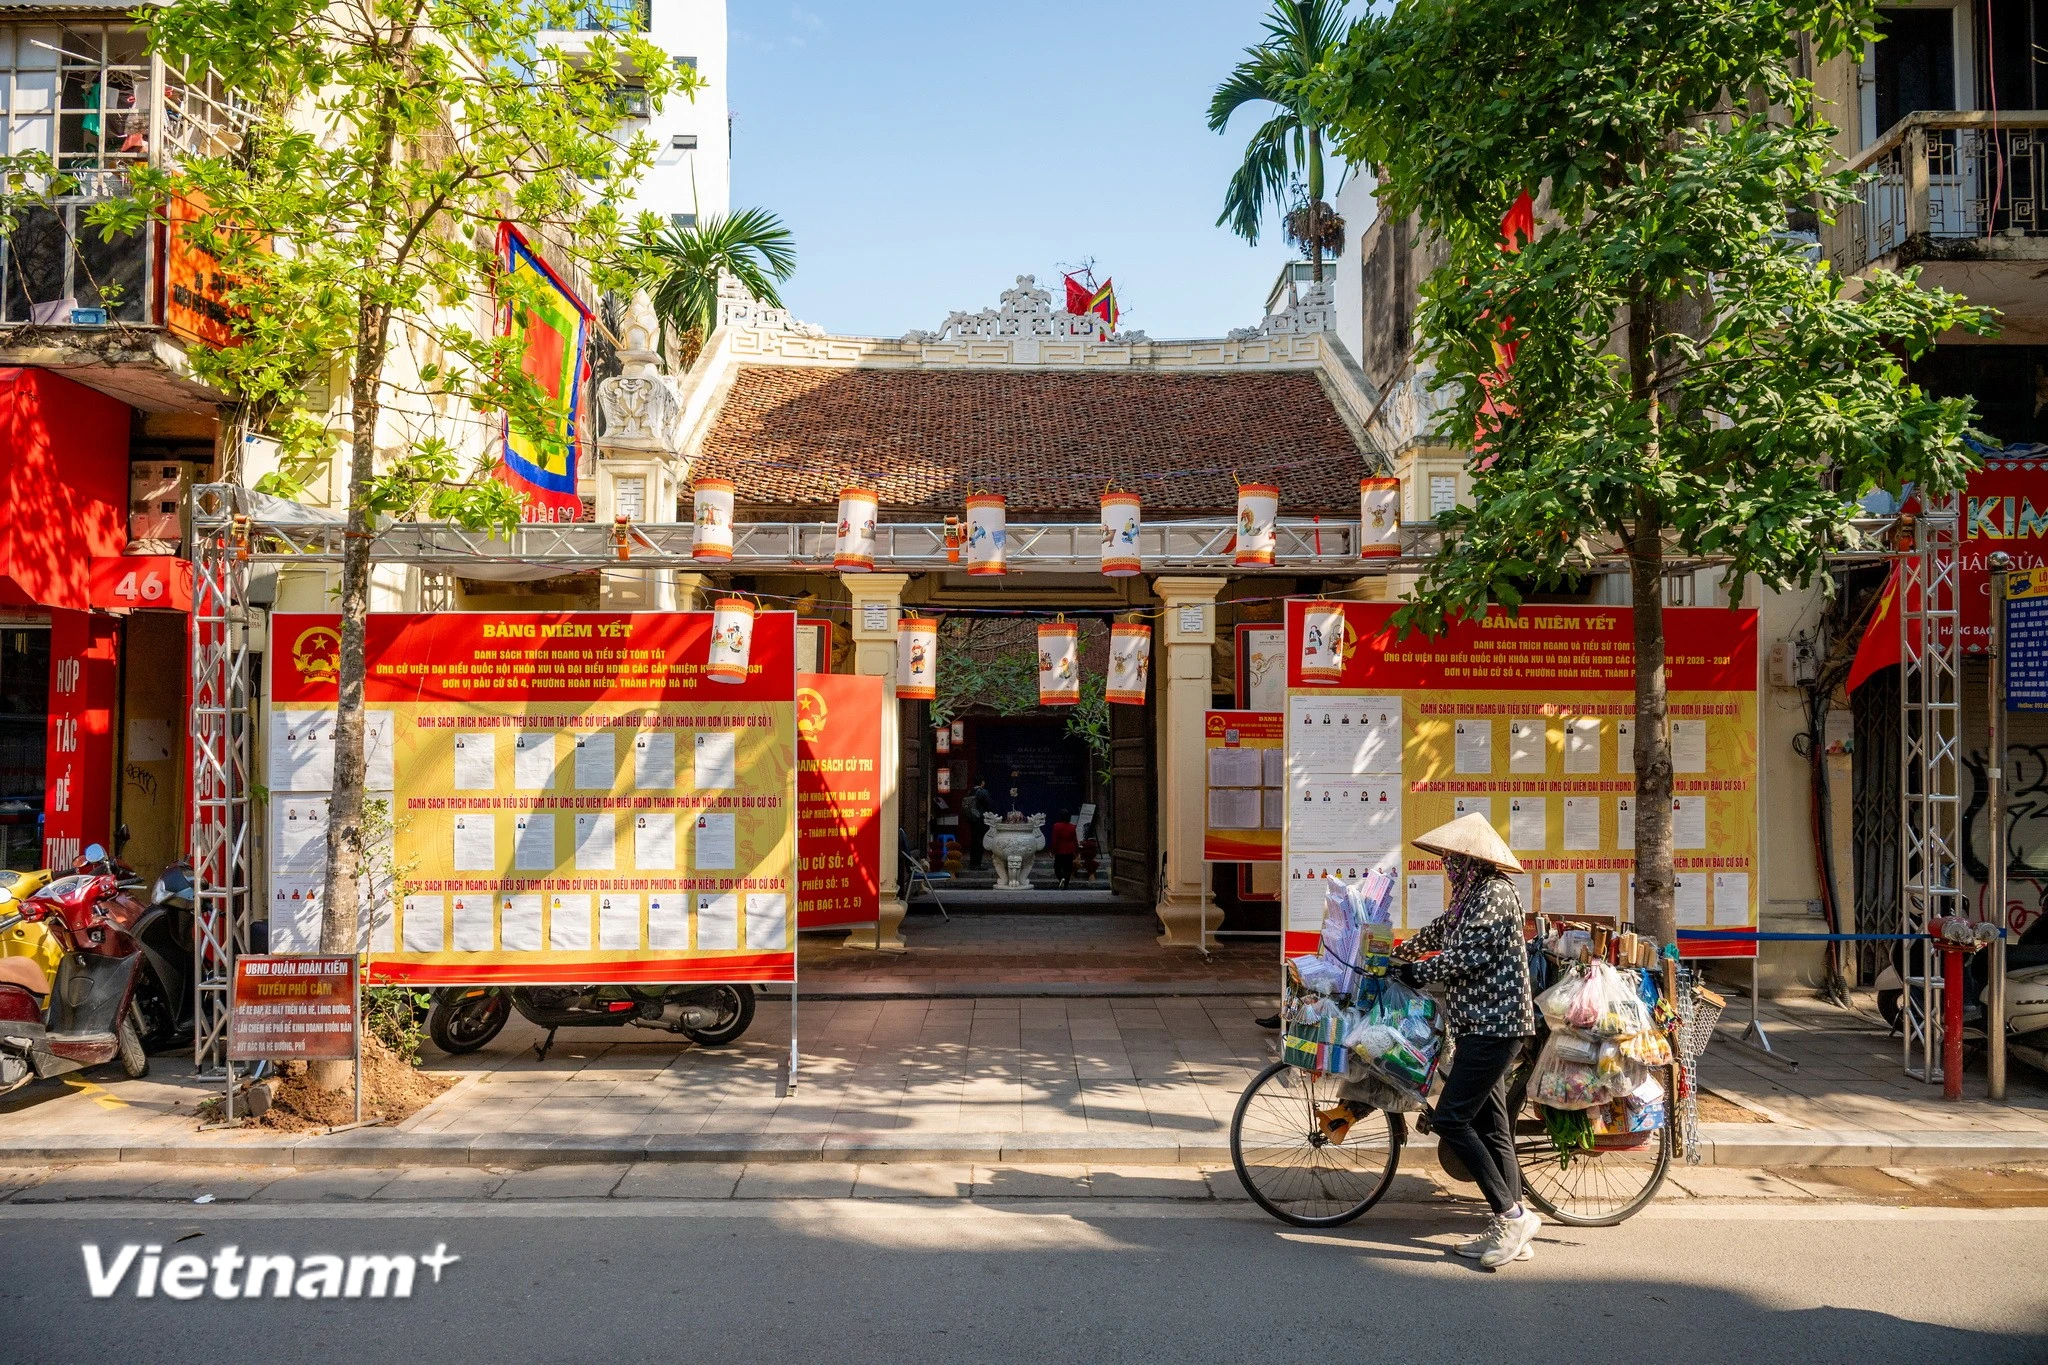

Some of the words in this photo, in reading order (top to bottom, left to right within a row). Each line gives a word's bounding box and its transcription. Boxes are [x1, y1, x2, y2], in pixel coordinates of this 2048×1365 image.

[1967, 496, 2048, 539] KIM
[115, 571, 163, 601] 46
[483, 621, 536, 637] BẢNG
[542, 622, 592, 637] NIÊM
[597, 620, 633, 637] YẾT
[1482, 613, 1529, 629] BẢNG
[1534, 615, 1580, 629] NIÊM
[1585, 614, 1616, 630] YẾT
[474, 651, 497, 659] DANH
[500, 650, 522, 659] SÁCH
[524, 649, 549, 659] TRÍCH
[552, 651, 580, 659] NGANG
[582, 649, 593, 659] VÀ
[596, 648, 613, 659] TIỂU
[616, 648, 627, 659] SỬ
[630, 649, 649, 659] TÓM
[651, 648, 665, 659] TẮT
[1473, 641, 1494, 649] DANH
[1497, 641, 1517, 649] SÁCH
[1519, 641, 1541, 649] TRÍCH
[1543, 642, 1568, 650] NGANG
[1571, 642, 1581, 650] VÀ
[1583, 641, 1599, 650] TIỂU
[1601, 641, 1612, 650] SỬ
[1614, 642, 1630, 650] TÓM
[1384, 652, 1400, 662] ỨNG
[1402, 652, 1413, 662] CỬ
[1415, 653, 1432, 662] VIÊN
[1435, 654, 1448, 663] ĐẠI
[1450, 653, 1468, 662] BIỂU
[1470, 652, 1491, 663] QUỐC
[1493, 654, 1506, 663] HỘI
[1508, 654, 1529, 663] KHÓA
[1545, 654, 1556, 663] VÀ
[1557, 656, 1571, 665] ĐẠI
[1573, 653, 1590, 664] BIỂU
[1592, 656, 1613, 664] HĐND
[1615, 656, 1630, 664] CÁC
[57, 656, 79, 696] HỢP
[376, 664, 394, 674] ỨNG
[396, 663, 408, 674] CỬ
[410, 664, 429, 674] VIÊN
[432, 665, 446, 675] ĐẠI
[449, 662, 468, 674] BIỂU
[471, 662, 493, 674] QUỐC
[496, 663, 510, 675] HỘI
[513, 663, 536, 673] KHÓA
[538, 665, 552, 673] XVI
[554, 663, 565, 673] VÀ
[567, 665, 582, 675] ĐẠI
[585, 662, 604, 673] BIỂU
[607, 664, 630, 674] HĐND
[632, 663, 649, 674] CÁC
[651, 662, 667, 674] CẤP
[670, 663, 698, 674] NHIỆM
[747, 663, 763, 673] 031
[1444, 668, 1460, 676] ĐƠN
[1462, 668, 1471, 676] VỊ
[1473, 666, 1488, 676] BẦU
[1490, 667, 1501, 676] CỬ
[1503, 666, 1513, 676] SỐ
[1525, 668, 1556, 677] PHƯỜNG
[1558, 668, 1578, 677] HOÀN
[1605, 668, 1628, 677] THÀNH
[442, 679, 460, 688] ĐƠN
[462, 679, 471, 689] VỊ
[474, 676, 491, 688] BẦU
[493, 677, 505, 688] CỬ
[507, 676, 519, 688] SỐ
[521, 679, 529, 688] 4,
[532, 678, 565, 687] PHƯỜNG
[568, 678, 590, 687] HOÀN
[620, 677, 647, 688] THÀNH
[649, 676, 666, 688] PHỐ
[669, 678, 680, 687] HÀ
[683, 678, 697, 689] NỘI
[56, 712, 77, 752] TÁC
[822, 757, 843, 771] SÁCH
[846, 756, 857, 771] CỬ
[859, 759, 873, 771] TRI
[55, 764, 71, 812] ĐỂ
[812, 853, 826, 869] CỬ
[828, 850, 844, 869] SỐ:
[847, 855, 853, 867] 4
[802, 876, 823, 891] PHIẾU
[826, 874, 838, 889] SỐ:
[841, 878, 849, 888] 15
[798, 899, 814, 912] ÀNG
[817, 899, 833, 912] BẠC
[854, 896, 862, 907] 5)
[245, 963, 269, 975] UBND
[271, 961, 295, 976] QUẬN
[297, 961, 323, 974] HOÀN
[324, 959, 348, 974] KIẾM
[257, 980, 286, 996] TUYẾN
[288, 979, 307, 995] PHỐ
